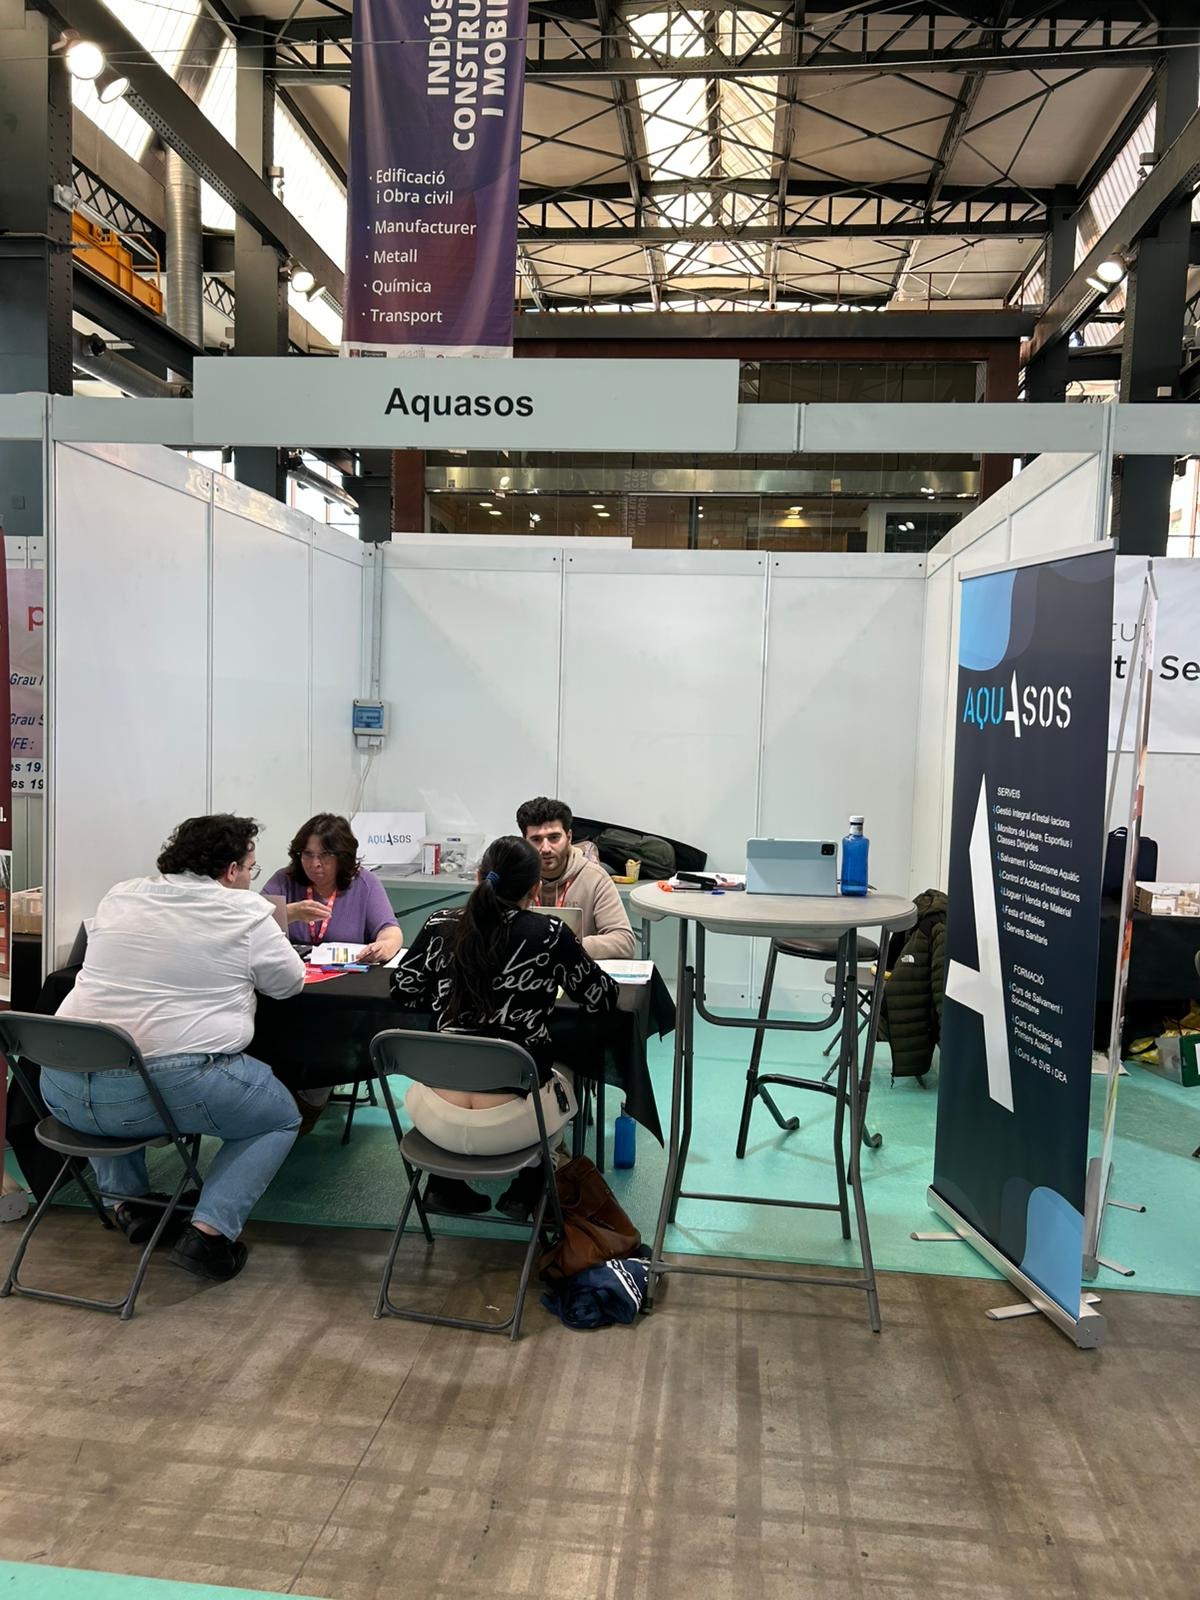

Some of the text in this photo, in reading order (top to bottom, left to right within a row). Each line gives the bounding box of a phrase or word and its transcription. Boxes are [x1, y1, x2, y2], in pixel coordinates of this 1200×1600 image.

[376, 168, 446, 185] Edificació
[376, 188, 454, 204] i Obra civil
[375, 219, 477, 235] Manufacturer
[374, 249, 418, 264] Metall
[372, 278, 432, 296] Química
[370, 309, 443, 326] Transport
[384, 387, 534, 422] Aquasos
[10, 673, 37, 686] Grau
[963, 669, 1072, 738] AQUASOS
[997, 787, 1021, 799] SERVEIS
[996, 805, 1012, 817] Gestió
[1013, 809, 1031, 821] Integral
[368, 833, 412, 846] AQUASOS
[997, 834, 1039, 852] Classes Dirigides
[998, 824, 1018, 836] Monitors
[1019, 829, 1025, 837] de
[1044, 833, 1070, 848] Esportius
[1000, 853, 1026, 867] Salvament
[1029, 860, 1058, 877] Socorrisme
[1059, 869, 1080, 883] Aquàtic
[1001, 870, 1019, 883] Control
[1003, 888, 1021, 900] Lloguer
[1025, 894, 1041, 907] Venda
[1042, 901, 1049, 910] de
[1050, 902, 1072, 918] Material
[1005, 905, 1018, 918] Festa
[1007, 922, 1048, 946] Serveis Sanitaris
[1013, 964, 1044, 985] FORMACIÓ
[1011, 983, 1024, 996] Curs
[1025, 990, 1031, 999] de
[1032, 992, 1060, 1014] Salvament
[1011, 994, 1040, 1015] Socorrisme
[1014, 1027, 1052, 1054] Primers Auxilis
[1015, 1016, 1027, 1029] Curs
[1054, 1037, 1062, 1048] als
[1018, 1048, 1030, 1062] Curs
[1030, 1056, 1037, 1066] de
[1054, 1068, 1068, 1084] DEA
